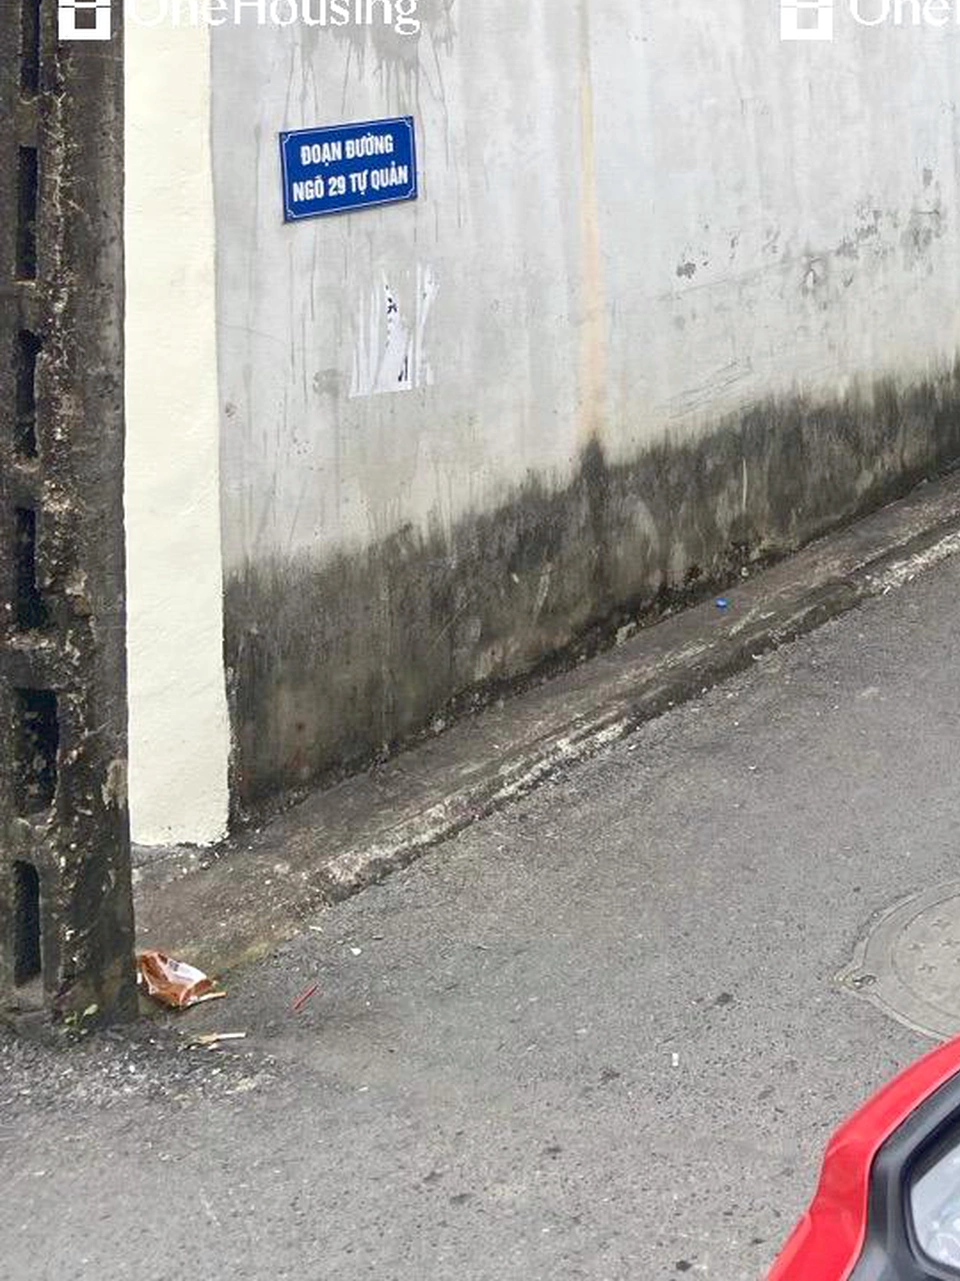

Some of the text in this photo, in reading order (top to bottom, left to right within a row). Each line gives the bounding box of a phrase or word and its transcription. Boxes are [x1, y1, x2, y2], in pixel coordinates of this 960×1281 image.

[301, 132, 394, 166] ĐOẠN ĐƯỜNG
[292, 161, 408, 202] NGÕ 29 TỰ QUẢN
